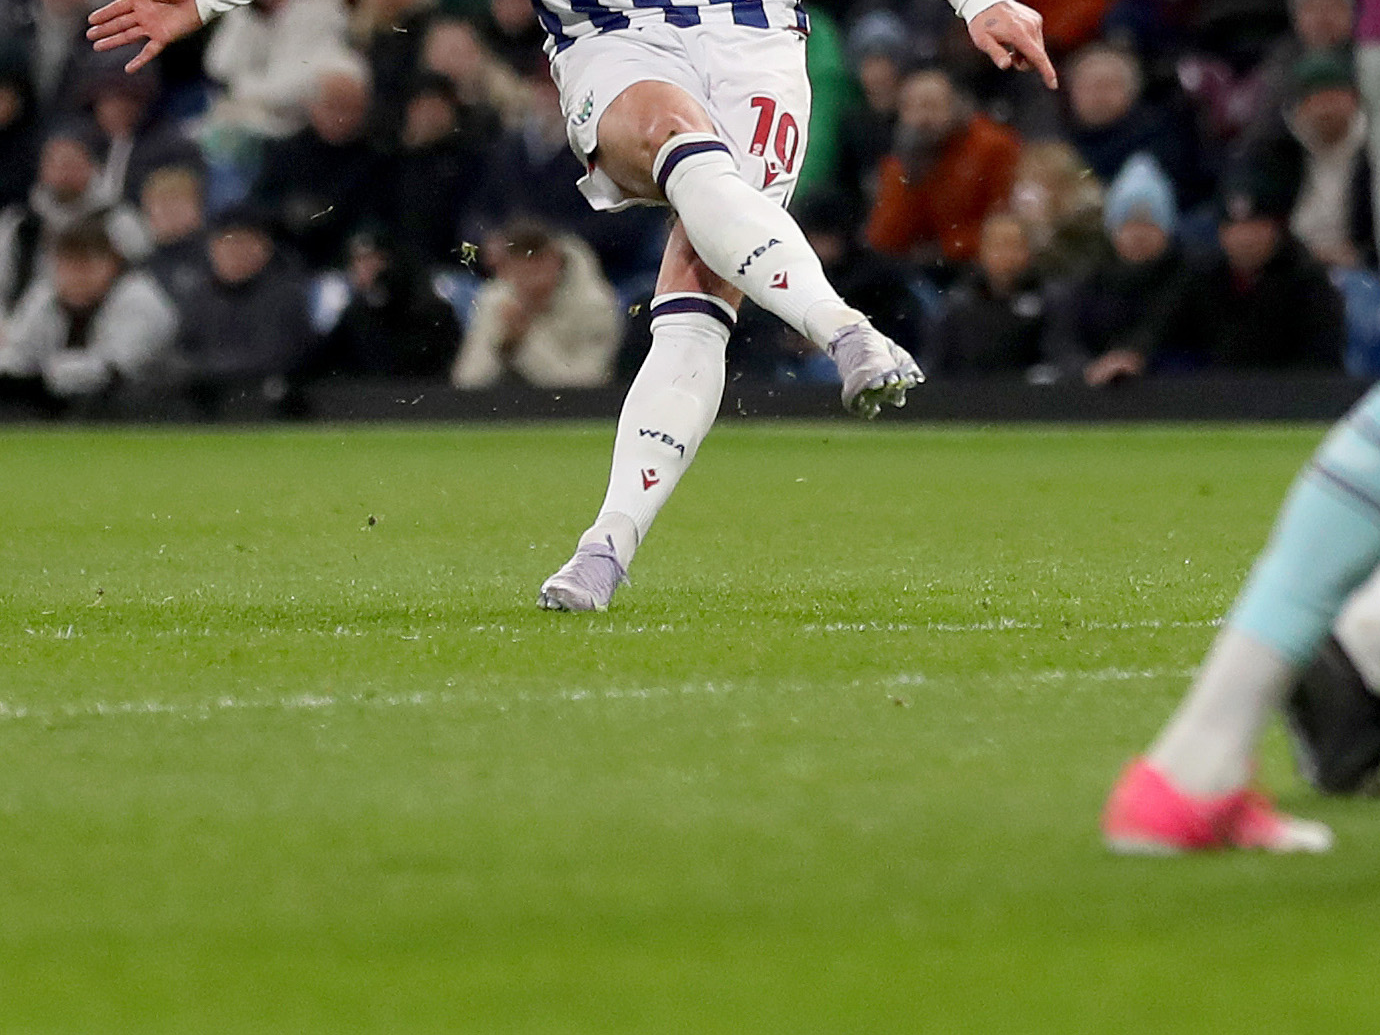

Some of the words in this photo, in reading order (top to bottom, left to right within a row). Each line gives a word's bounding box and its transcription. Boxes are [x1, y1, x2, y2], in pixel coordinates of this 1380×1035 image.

[749, 96, 799, 174] 10
[736, 238, 782, 275] WBA
[638, 428, 686, 459] WBA
